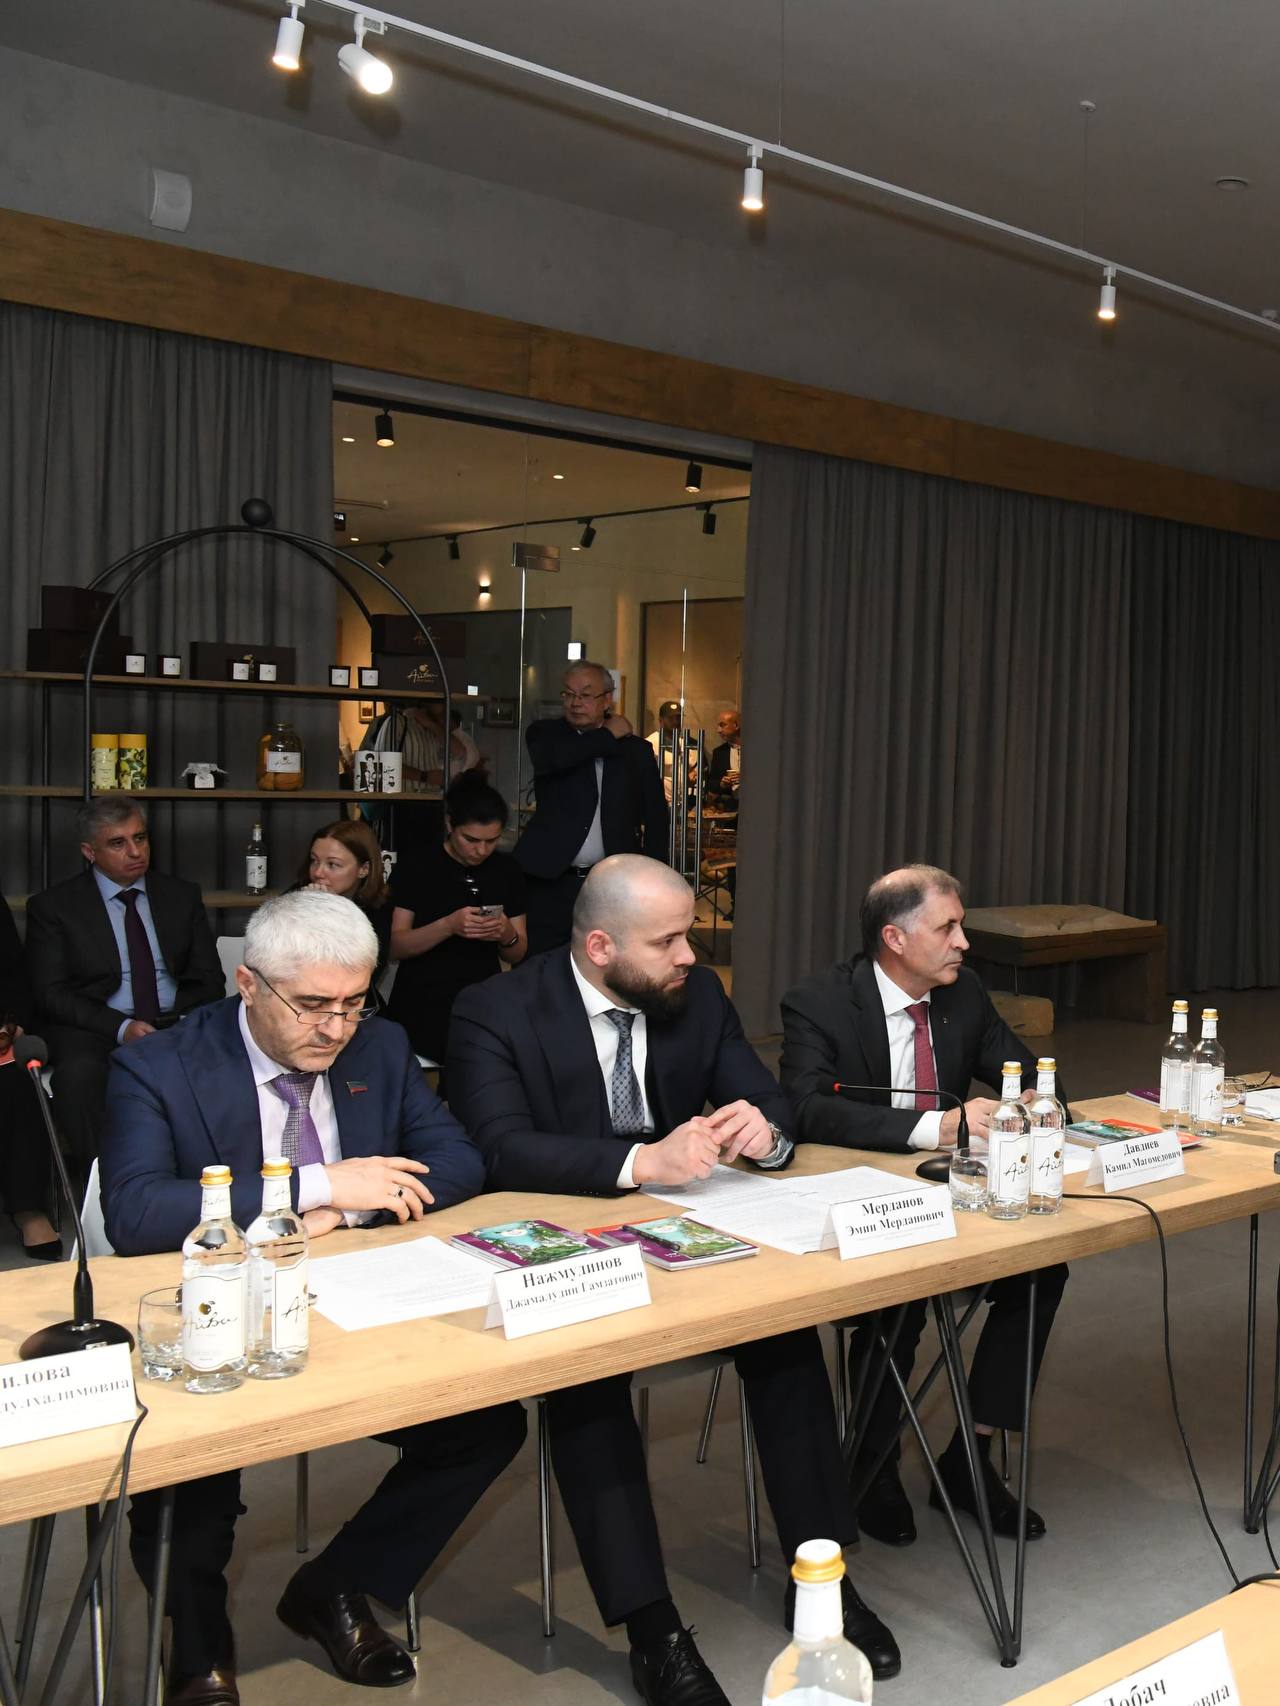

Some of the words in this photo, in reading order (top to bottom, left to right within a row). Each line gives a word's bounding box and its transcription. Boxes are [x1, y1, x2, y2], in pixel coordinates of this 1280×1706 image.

[1123, 1140, 1160, 1156] Давдиев
[1105, 1157, 1132, 1174] Камил
[1132, 1150, 1181, 1168] Магомедович
[862, 1197, 924, 1217] Мерданов
[845, 1224, 877, 1236] Эмин
[879, 1211, 944, 1231] Мерданович
[522, 1257, 622, 1288] Нажмудинов
[505, 1287, 578, 1312] Джамалудин
[581, 1271, 643, 1293] Гамзатович
